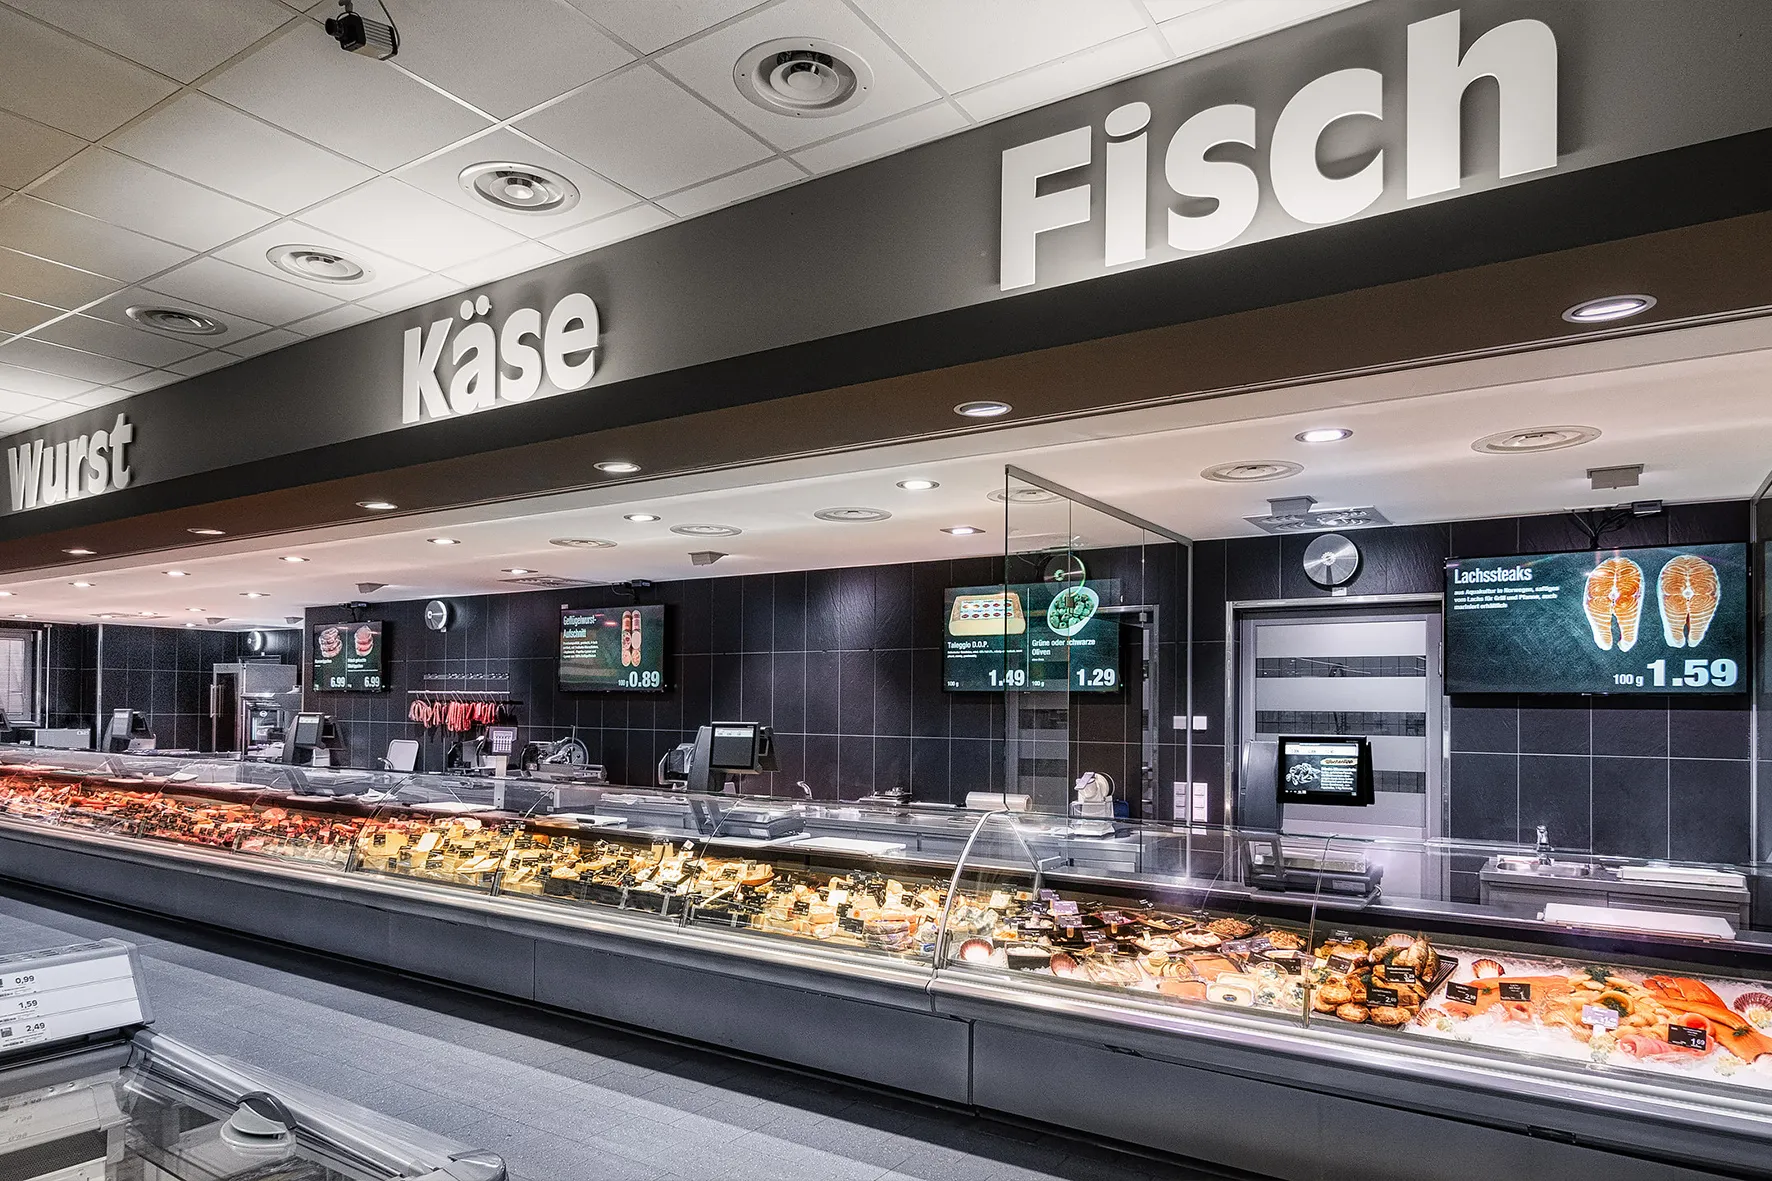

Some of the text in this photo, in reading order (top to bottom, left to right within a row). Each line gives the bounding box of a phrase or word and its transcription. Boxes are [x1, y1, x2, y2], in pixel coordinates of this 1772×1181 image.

[1001, 8, 1558, 291] Fisch
[402, 292, 600, 424] Käse
[8, 412, 133, 512] Wurst
[1454, 566, 1532, 584] Lachssteaks
[947, 640, 990, 650] Taleggio D.O.P.
[1031, 638, 1050, 647] Grüne
[1051, 638, 1066, 646] oder
[1031, 648, 1051, 656] Oliven
[629, 670, 660, 688] 0.89
[988, 669, 1026, 687] 1.49
[1076, 668, 1116, 687] 1.29
[1612, 673, 1644, 687] 100 g
[1646, 658, 1738, 687] 1.59
[15, 975, 35, 984] 0,99
[18, 999, 38, 1009] 1,59
[26, 1022, 46, 1032] 2,49
